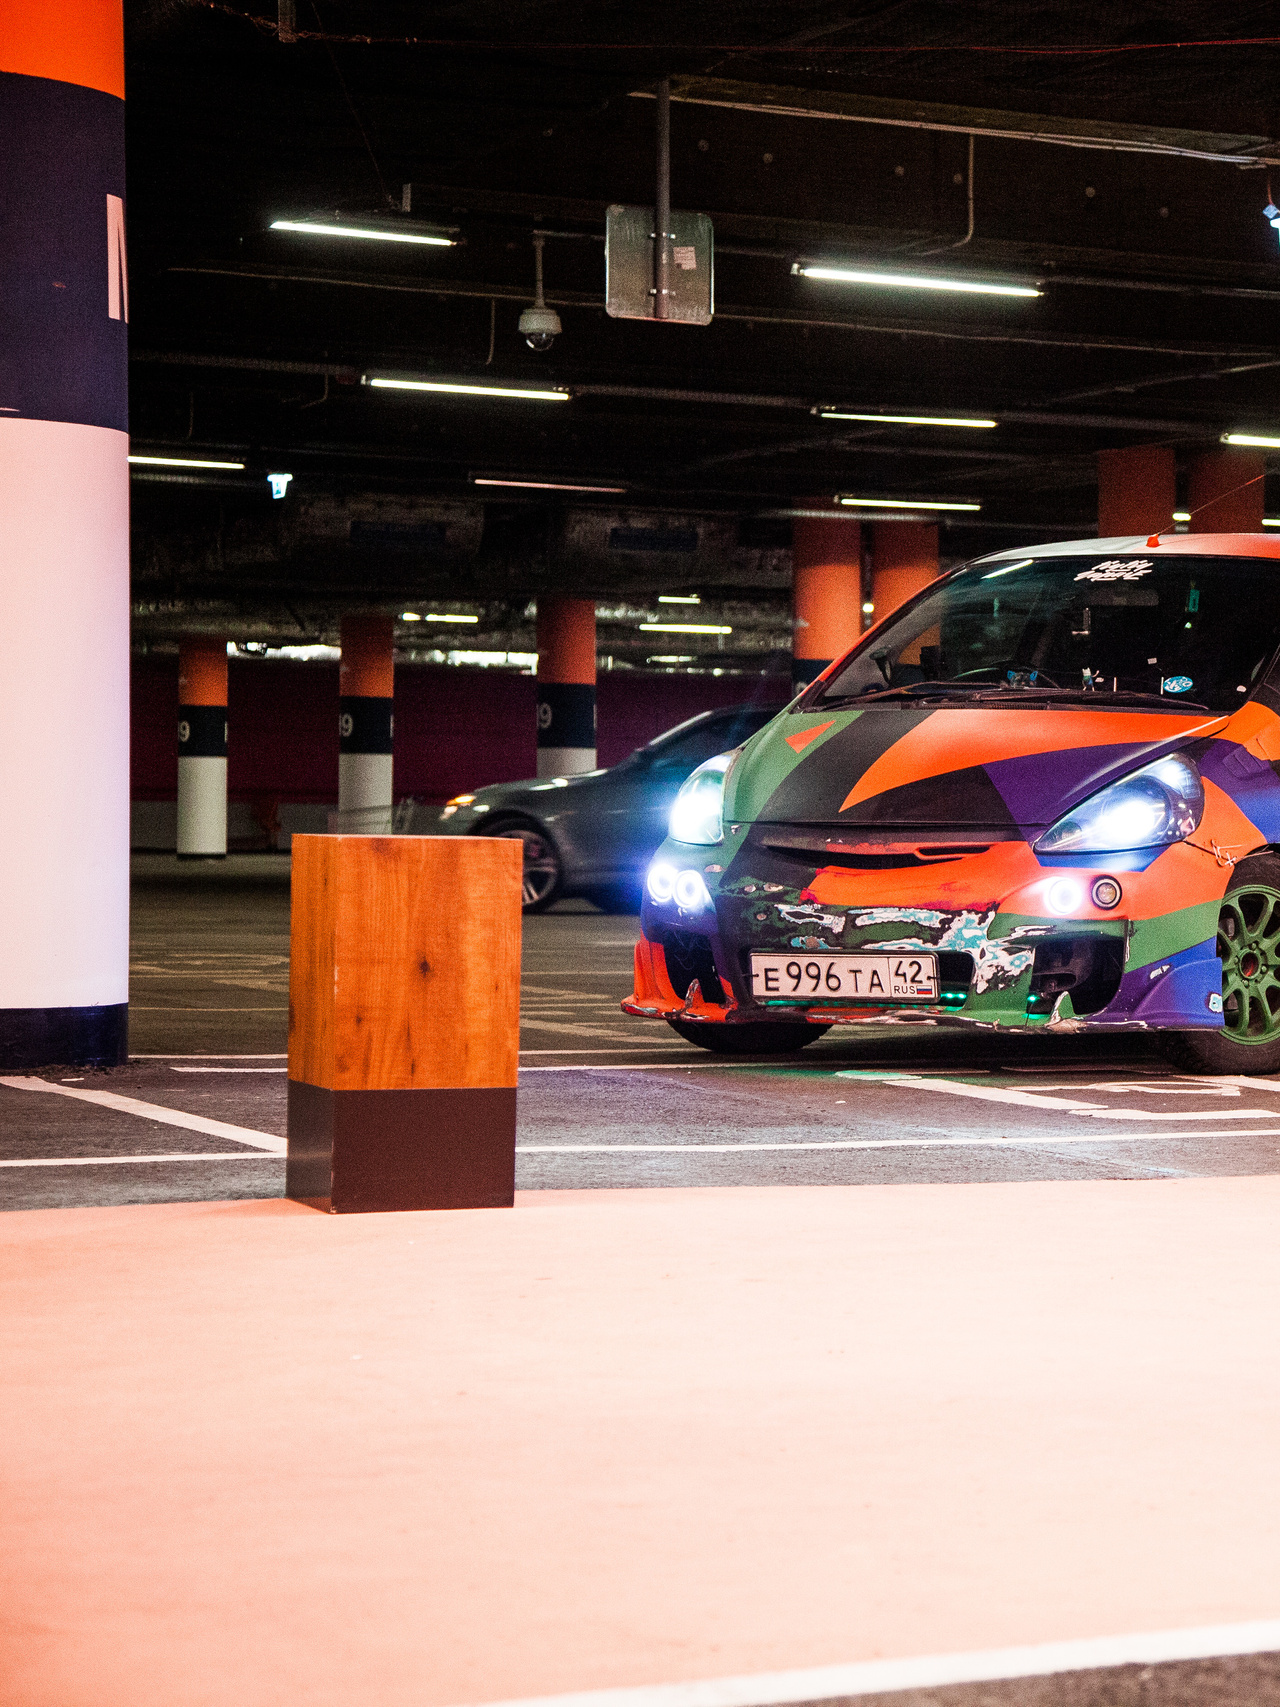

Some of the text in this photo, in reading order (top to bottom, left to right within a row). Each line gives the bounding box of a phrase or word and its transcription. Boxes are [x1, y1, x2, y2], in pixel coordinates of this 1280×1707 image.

[764, 960, 923, 993] E996TA 42
[893, 985, 916, 995] RUS
